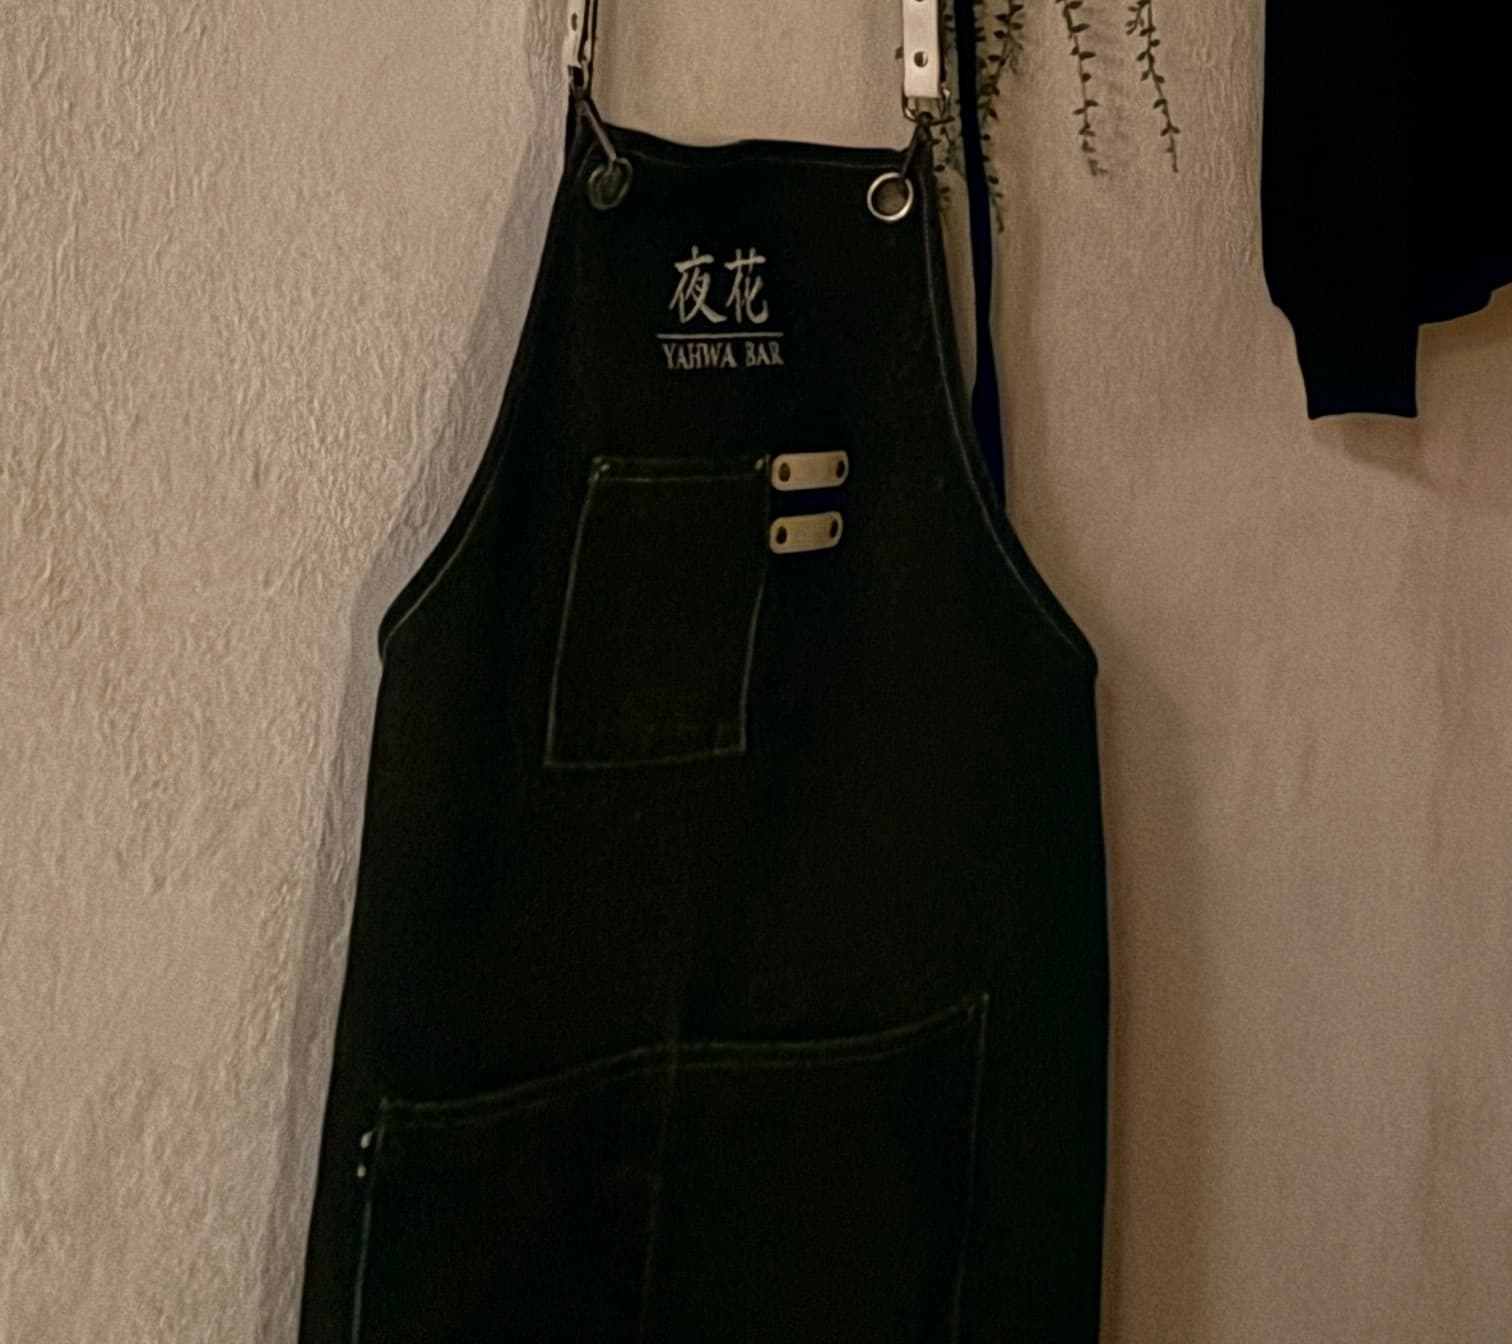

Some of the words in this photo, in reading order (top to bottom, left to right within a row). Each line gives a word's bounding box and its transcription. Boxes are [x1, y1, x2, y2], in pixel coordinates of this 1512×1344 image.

[668, 244, 770, 325] 夜花
[661, 342, 738, 370] YAHWA
[744, 340, 785, 368] BAR
